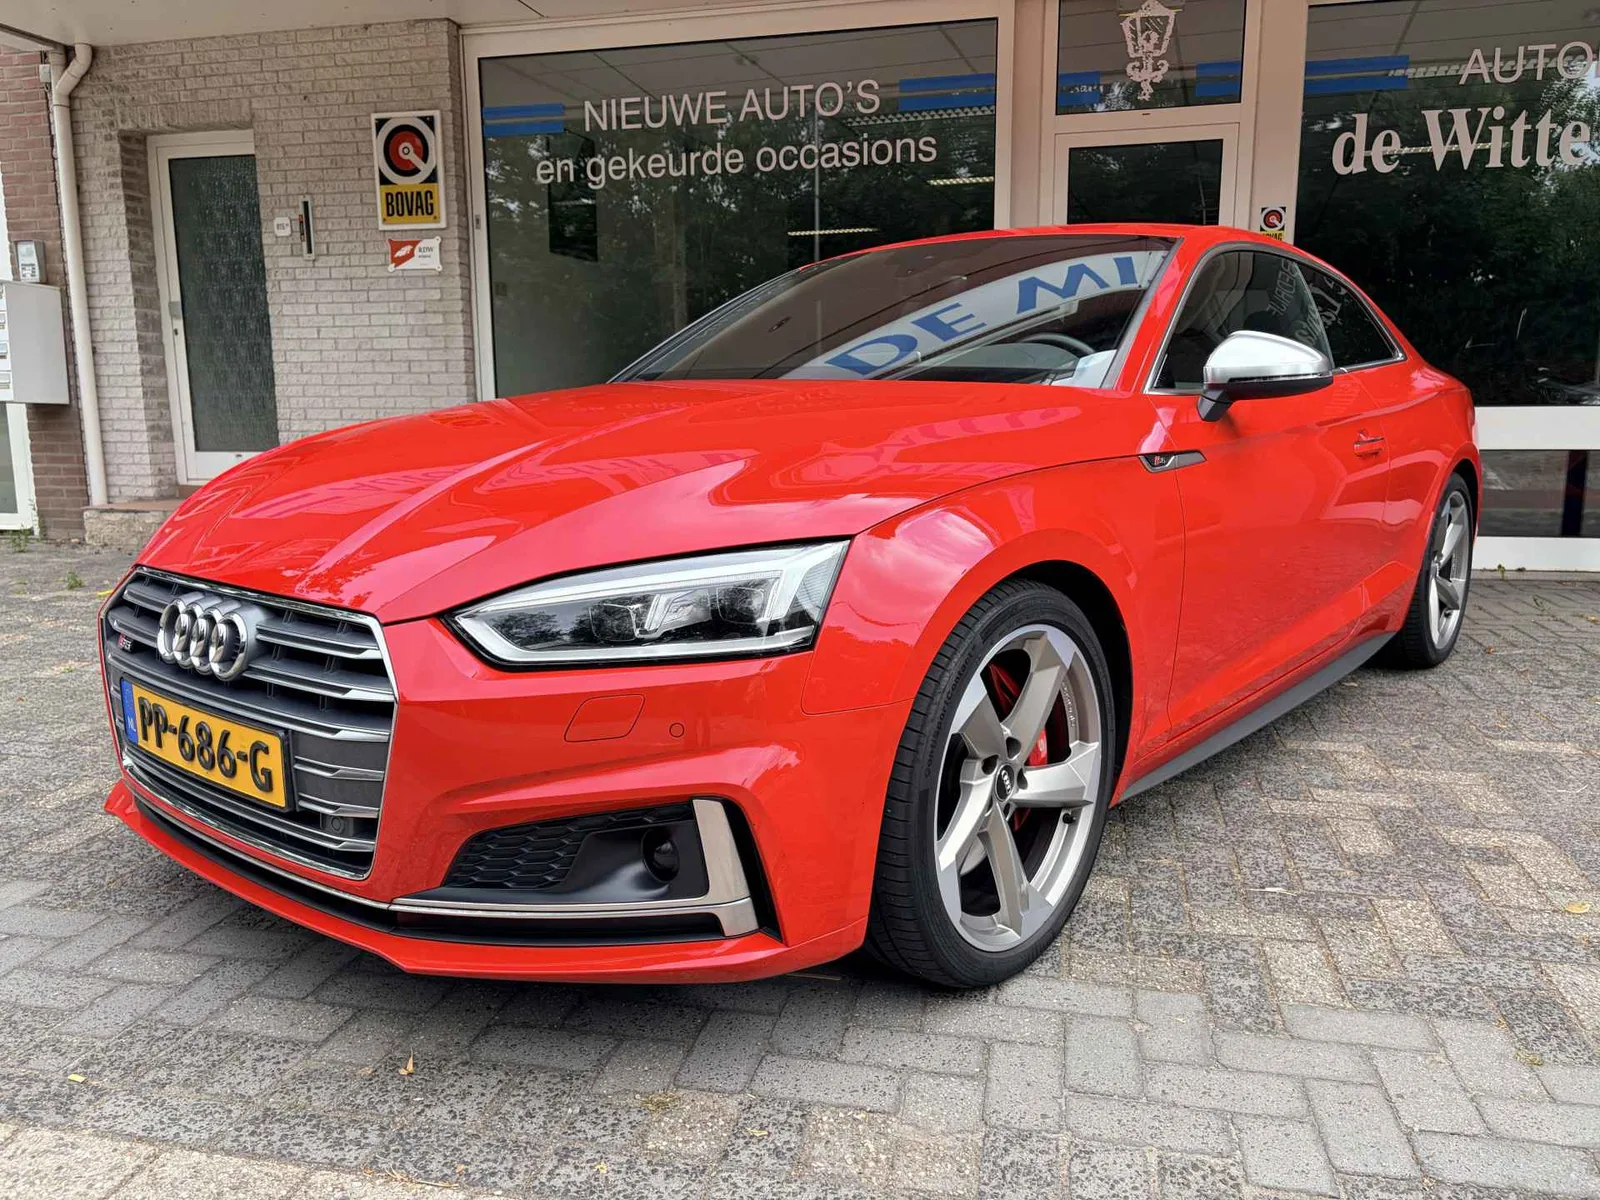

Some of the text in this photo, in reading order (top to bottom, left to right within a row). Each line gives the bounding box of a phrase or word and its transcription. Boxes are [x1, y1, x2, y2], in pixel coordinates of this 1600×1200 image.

[1459, 41, 1600, 85] AUTO
[583, 79, 882, 132] NIEUWE AUTO'S
[536, 132, 938, 190] en gekeurde occasions
[1332, 106, 1591, 175] de Witte
[385, 190, 434, 217] BOVAG
[138, 696, 274, 792] PP-686-G
